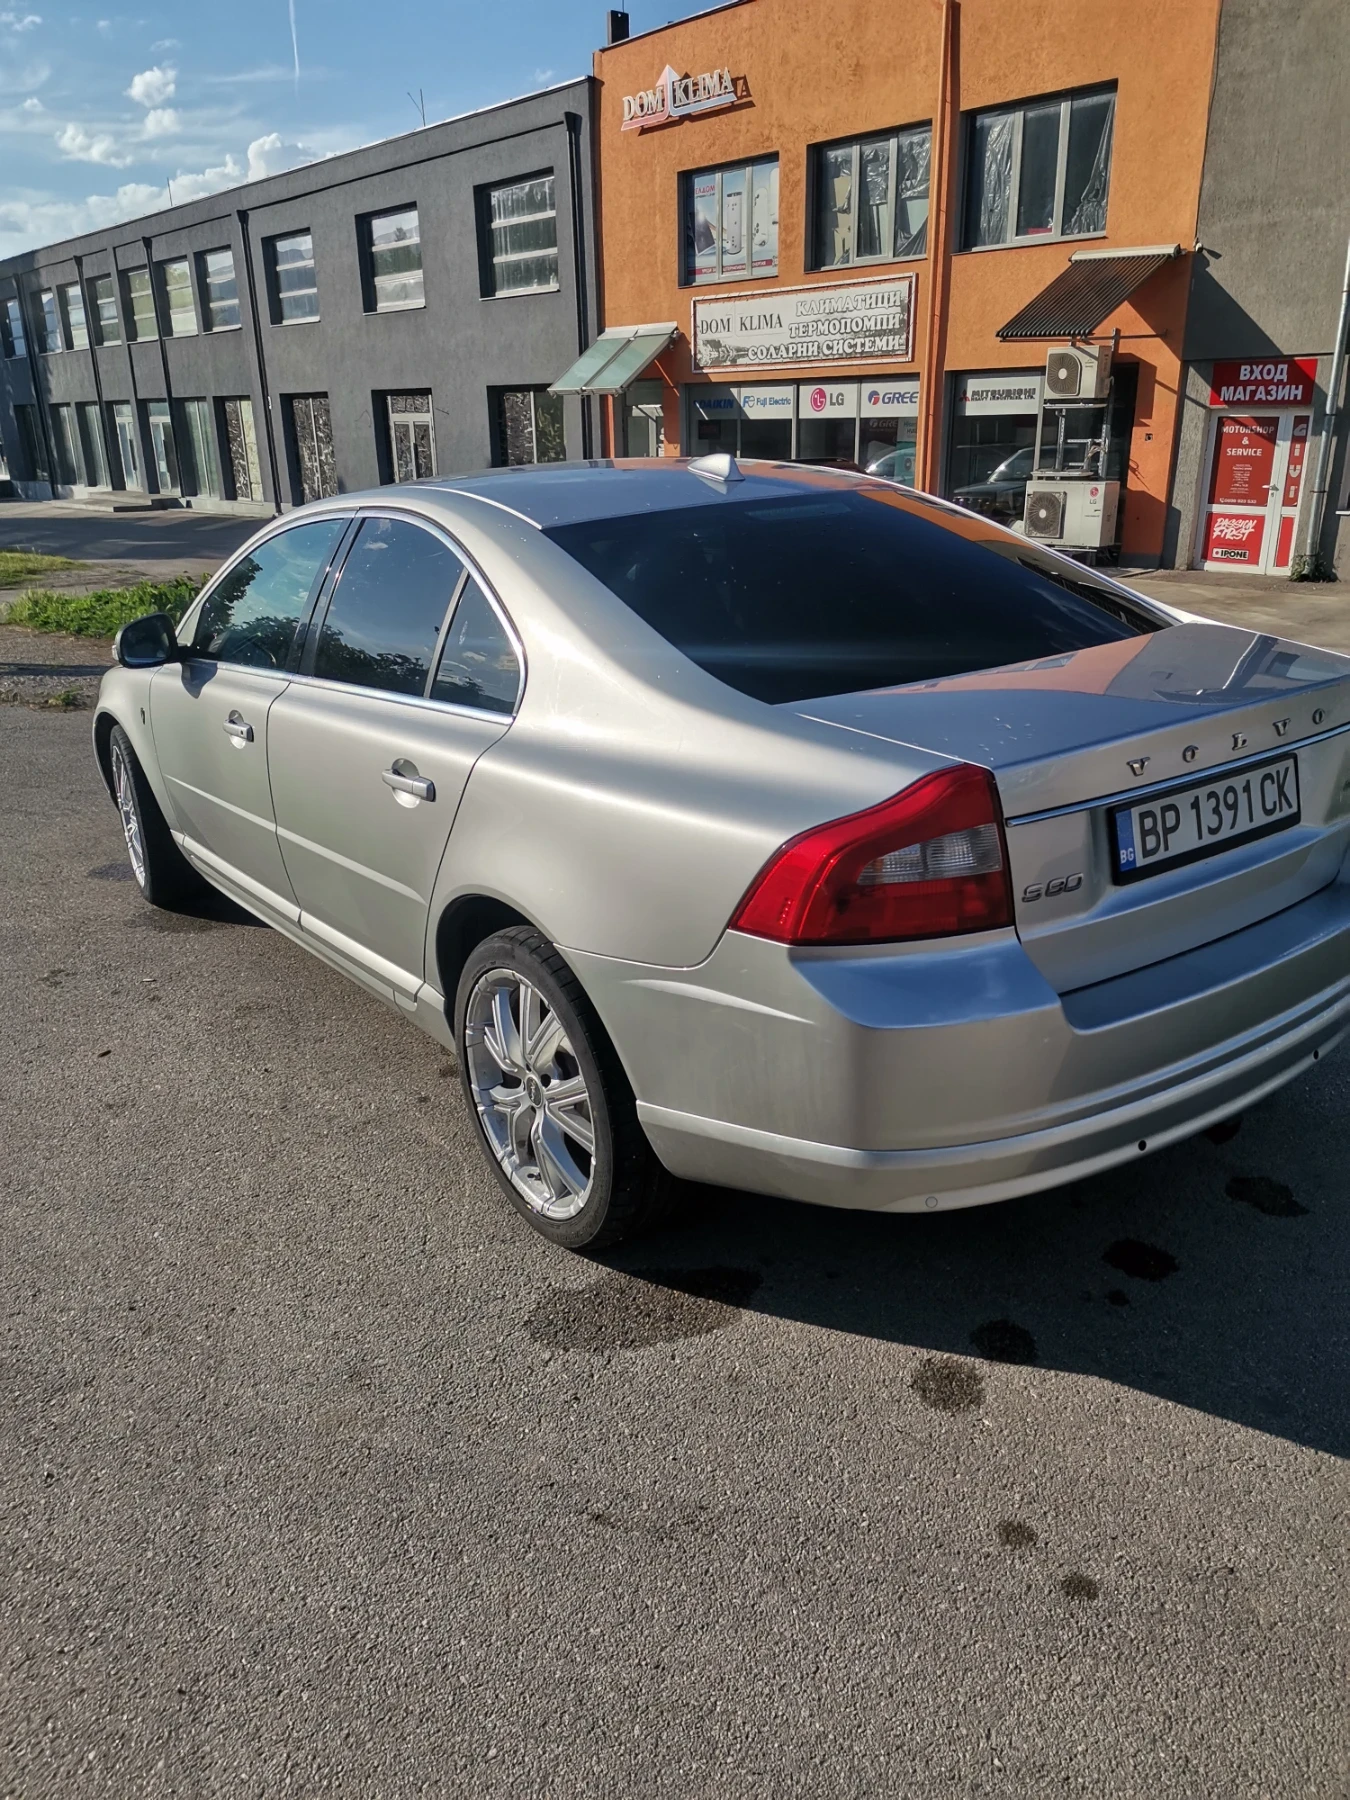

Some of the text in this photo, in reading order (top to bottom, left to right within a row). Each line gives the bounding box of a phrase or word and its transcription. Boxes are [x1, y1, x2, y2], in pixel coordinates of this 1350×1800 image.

[622, 67, 733, 121] DOM KLIMA
[796, 290, 902, 317] КЛИМАТИЦИ
[701, 313, 783, 335] DOM KLIMA
[788, 312, 902, 338] ТЕРМОПОМПИ
[748, 335, 901, 361] СОЛАРНИ СИСТЕМИ
[1239, 364, 1288, 382] ВХОД
[829, 392, 845, 406] LG
[882, 391, 919, 404] GREE
[1220, 385, 1303, 401] МАГАЗИН
[699, 398, 735, 409] DAIKIN
[756, 398, 766, 407] Fuji
[768, 397, 791, 406] Electric
[1221, 425, 1275, 434] MOTORSHOP
[1241, 436, 1249, 445] &
[1226, 448, 1262, 457] SERVICE
[1214, 518, 1257, 530] PASSION
[1212, 527, 1255, 541] FIRST
[1220, 550, 1248, 559] IPONE
[1126, 708, 1326, 777] VOLVO
[1138, 766, 1294, 859] BP 1391 CK
[1120, 848, 1134, 864] BG
